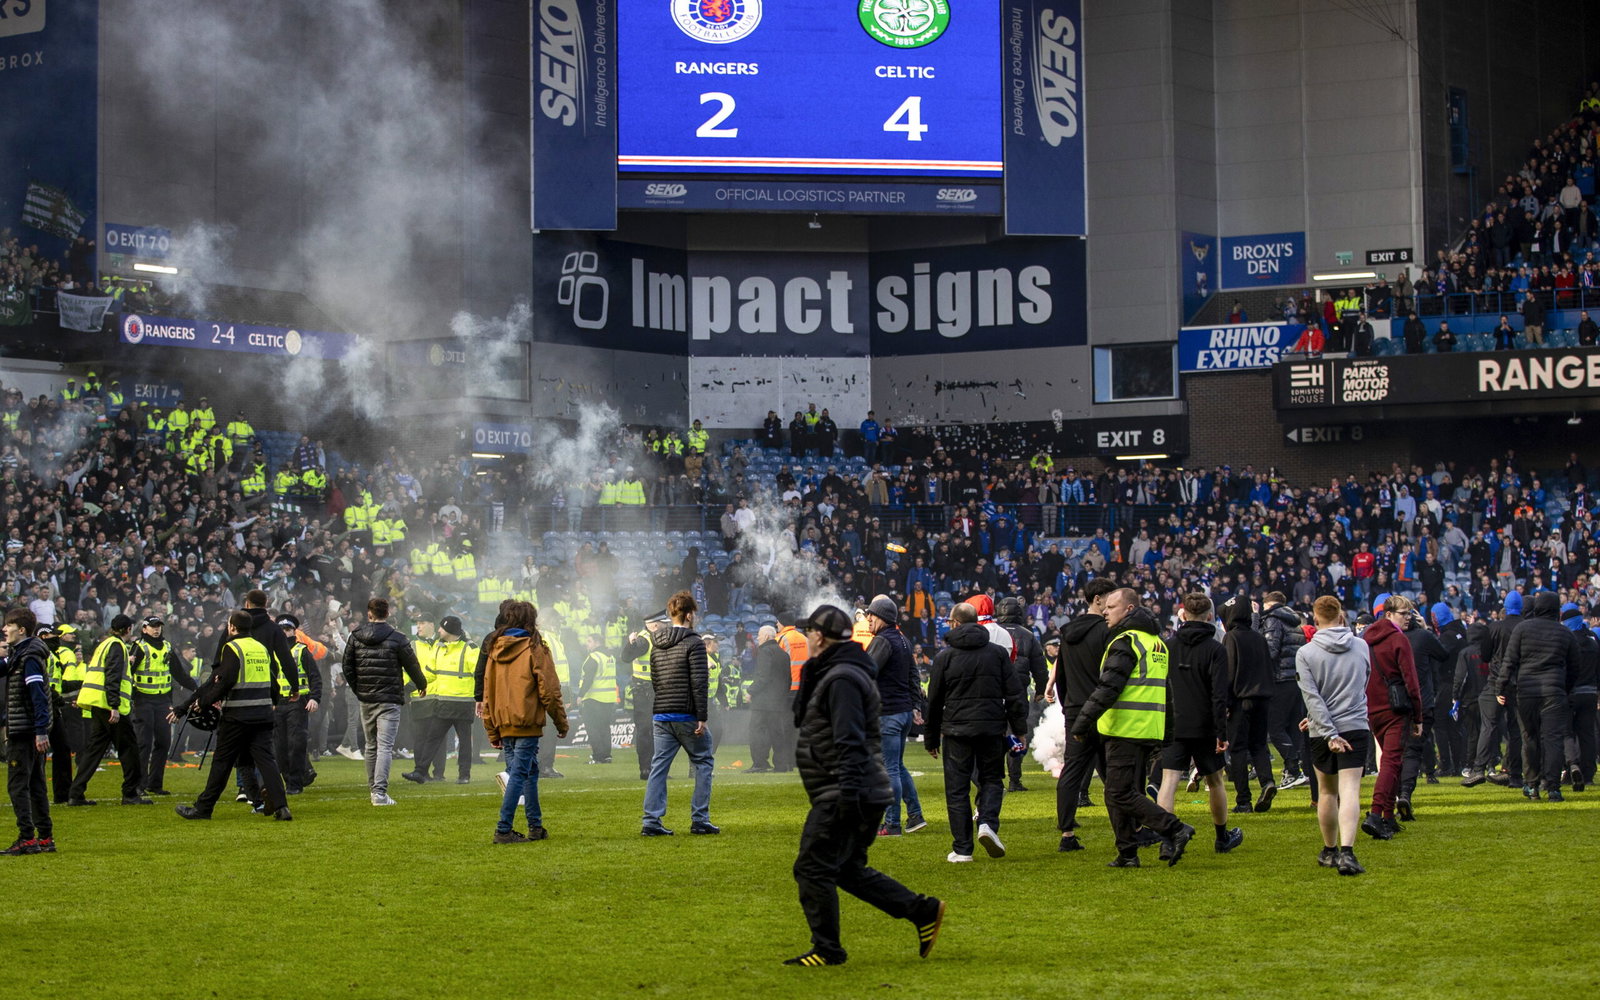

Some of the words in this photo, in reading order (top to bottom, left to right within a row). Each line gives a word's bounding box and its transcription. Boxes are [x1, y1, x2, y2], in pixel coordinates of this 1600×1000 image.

[1010, 7, 1024, 76] Intelligence
[540, 0, 577, 127] SEKO
[675, 61, 759, 75] RANGERS
[875, 65, 935, 79] CELTIC
[1041, 8, 1078, 147] SEKO
[594, 57, 609, 127] Intelligence
[696, 92, 738, 138] 2
[1013, 78, 1026, 136] Delivered
[883, 96, 928, 141] 4
[645, 183, 688, 198] SEKO
[715, 188, 774, 201] OFFICIAL
[777, 189, 846, 202] LOGISTICS
[849, 190, 905, 203] PARTNER
[936, 188, 978, 203] SEKO
[121, 232, 146, 248] EXIT
[1233, 243, 1293, 260] BROXI'S
[1371, 252, 1395, 263] EXIT
[1400, 250, 1408, 261] 8
[1247, 259, 1280, 274] DEN
[631, 258, 854, 340] Impact
[876, 262, 1052, 338] signs
[145, 325, 195, 341] RANGERS
[212, 325, 235, 344] 2-4
[248, 333, 284, 348] CELTIC
[1209, 327, 1280, 348] RHINO
[1343, 366, 1389, 379] PARK'S
[1478, 355, 1600, 392] RANGE
[135, 383, 157, 398] EXIT
[162, 385, 168, 398] 7
[1343, 378, 1389, 390] MOTOR
[1291, 395, 1324, 403] HOUSE
[1343, 389, 1388, 402] GROUP
[488, 431, 510, 445] EXIT
[513, 432, 519, 447] 7
[1097, 430, 1142, 447] EXIT
[1152, 428, 1166, 445] 8
[1301, 427, 1342, 442] EXIT
[1351, 425, 1363, 441] 8
[611, 734, 634, 745] OTOR
